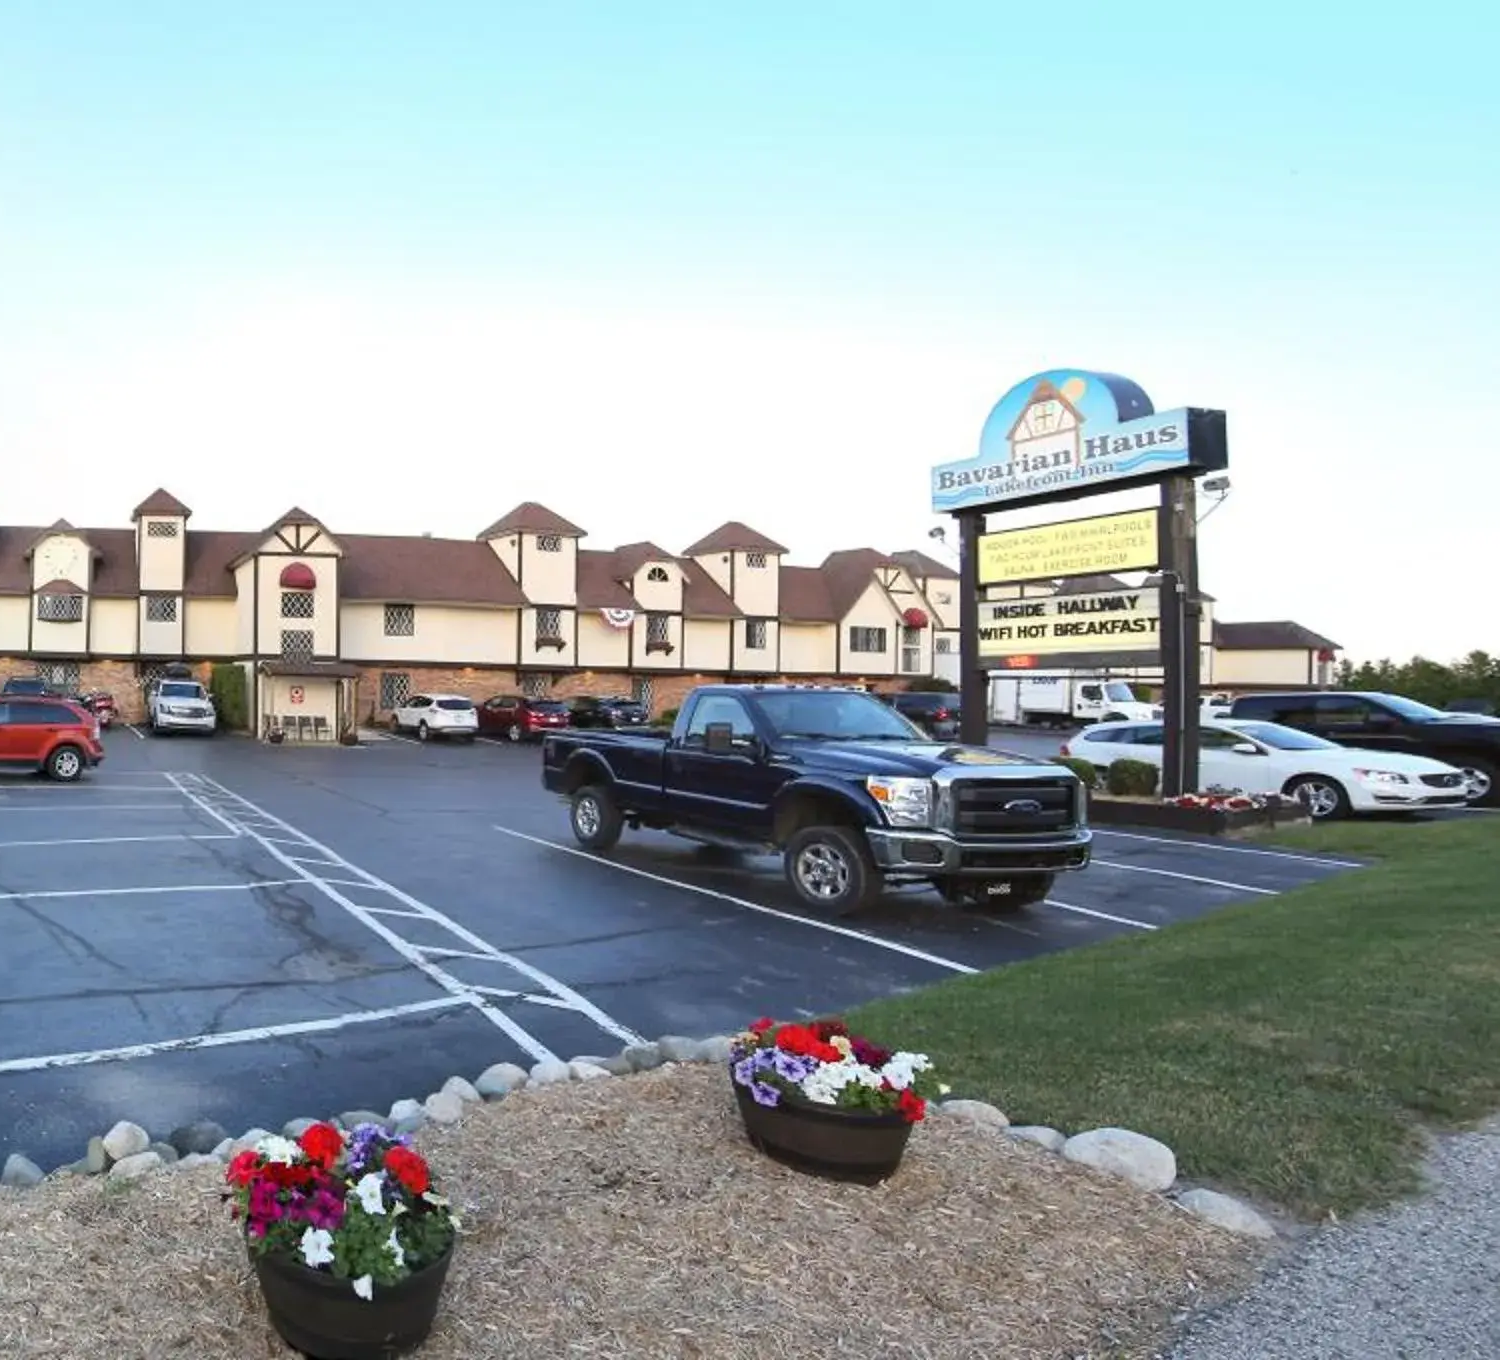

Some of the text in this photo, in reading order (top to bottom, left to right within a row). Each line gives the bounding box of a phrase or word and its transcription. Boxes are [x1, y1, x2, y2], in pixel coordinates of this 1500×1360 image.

[938, 424, 1178, 490] Bavarian Haus
[1079, 463, 1115, 479] Inn
[993, 595, 1140, 620] INSIDE HALLWAY
[979, 617, 1159, 641] WIFI HOT BREAKFAST
